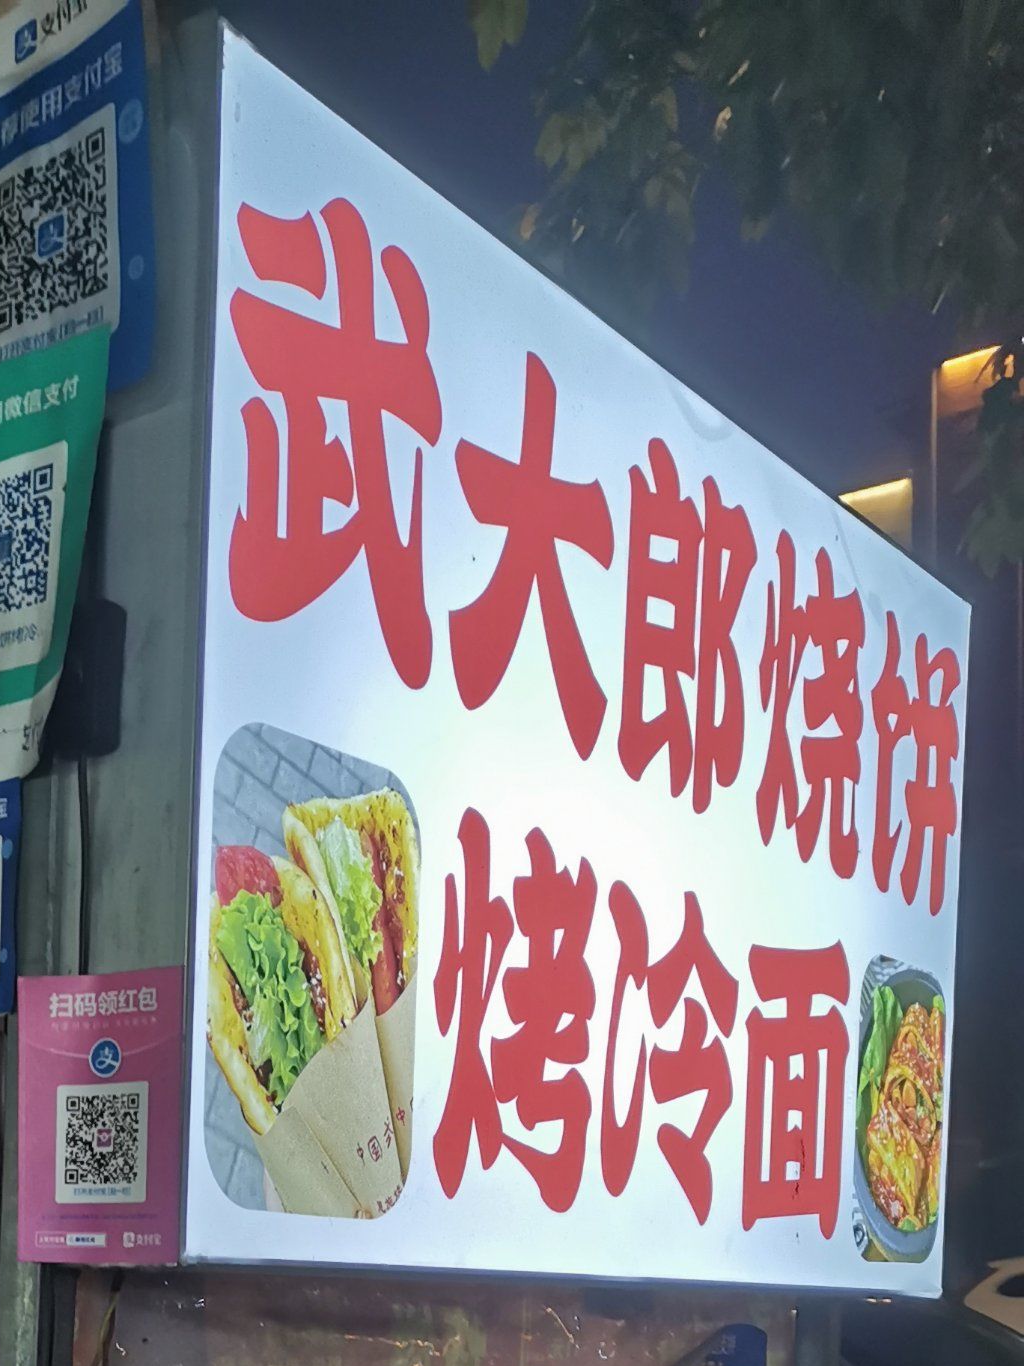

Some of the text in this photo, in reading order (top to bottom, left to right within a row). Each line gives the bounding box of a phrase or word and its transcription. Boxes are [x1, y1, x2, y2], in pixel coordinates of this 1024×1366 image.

[229, 197, 960, 916] 武大郎烧饼
[49, 987, 157, 1018] 扫码领红包
[432, 806, 851, 1240] 烤冷面
